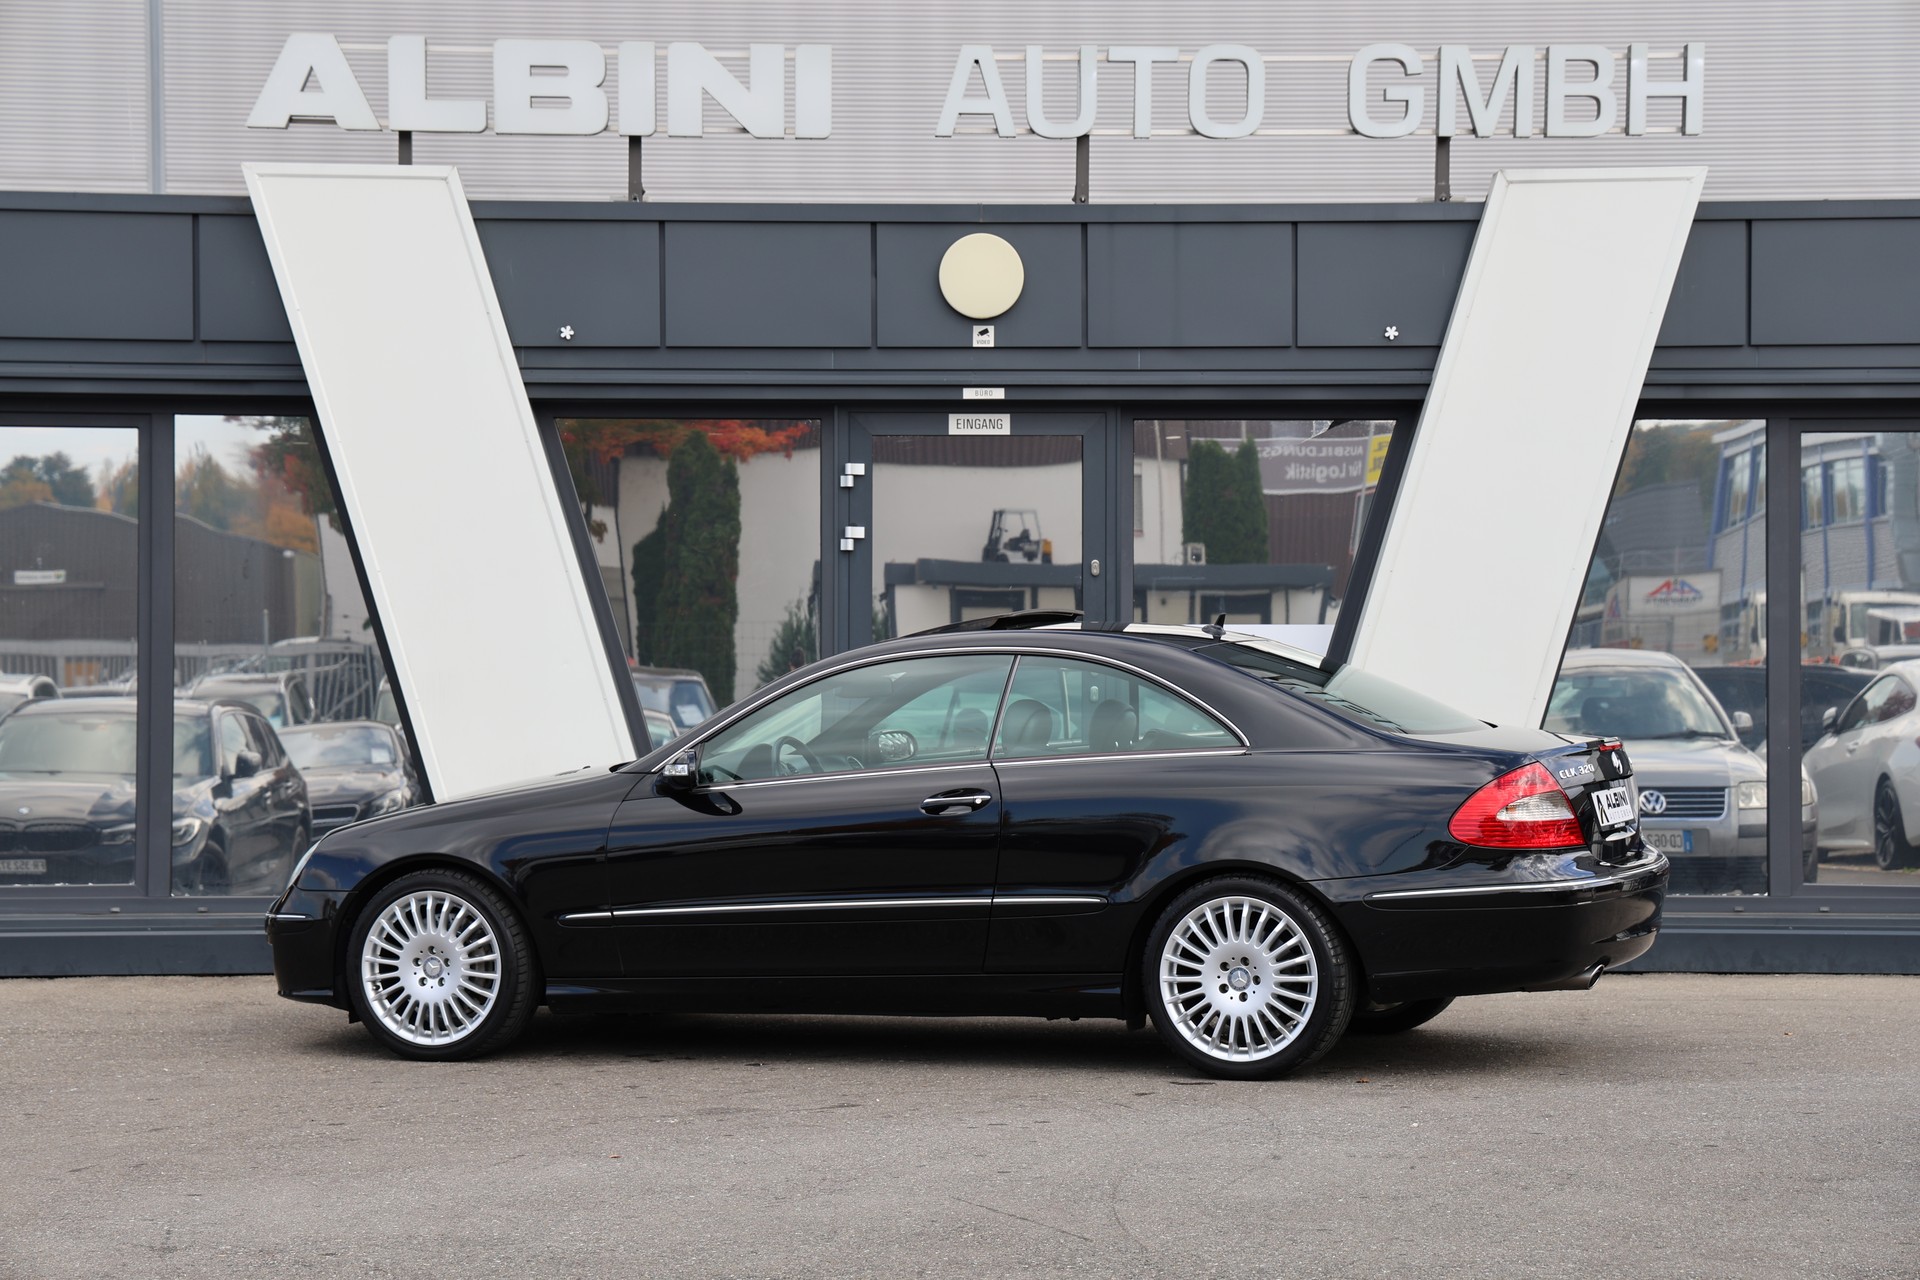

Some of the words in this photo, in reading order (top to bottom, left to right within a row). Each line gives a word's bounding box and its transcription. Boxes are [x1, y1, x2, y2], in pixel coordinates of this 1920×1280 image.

[246, 33, 832, 139] ALBINI
[935, 44, 1265, 139] AUTO
[1347, 42, 1706, 140] GMBH
[974, 389, 994, 397] BÜRO
[956, 418, 1003, 430] EINGANG
[1559, 768, 1578, 780] CLK
[1578, 764, 1595, 775] 320
[1605, 790, 1629, 809] ALBINI
